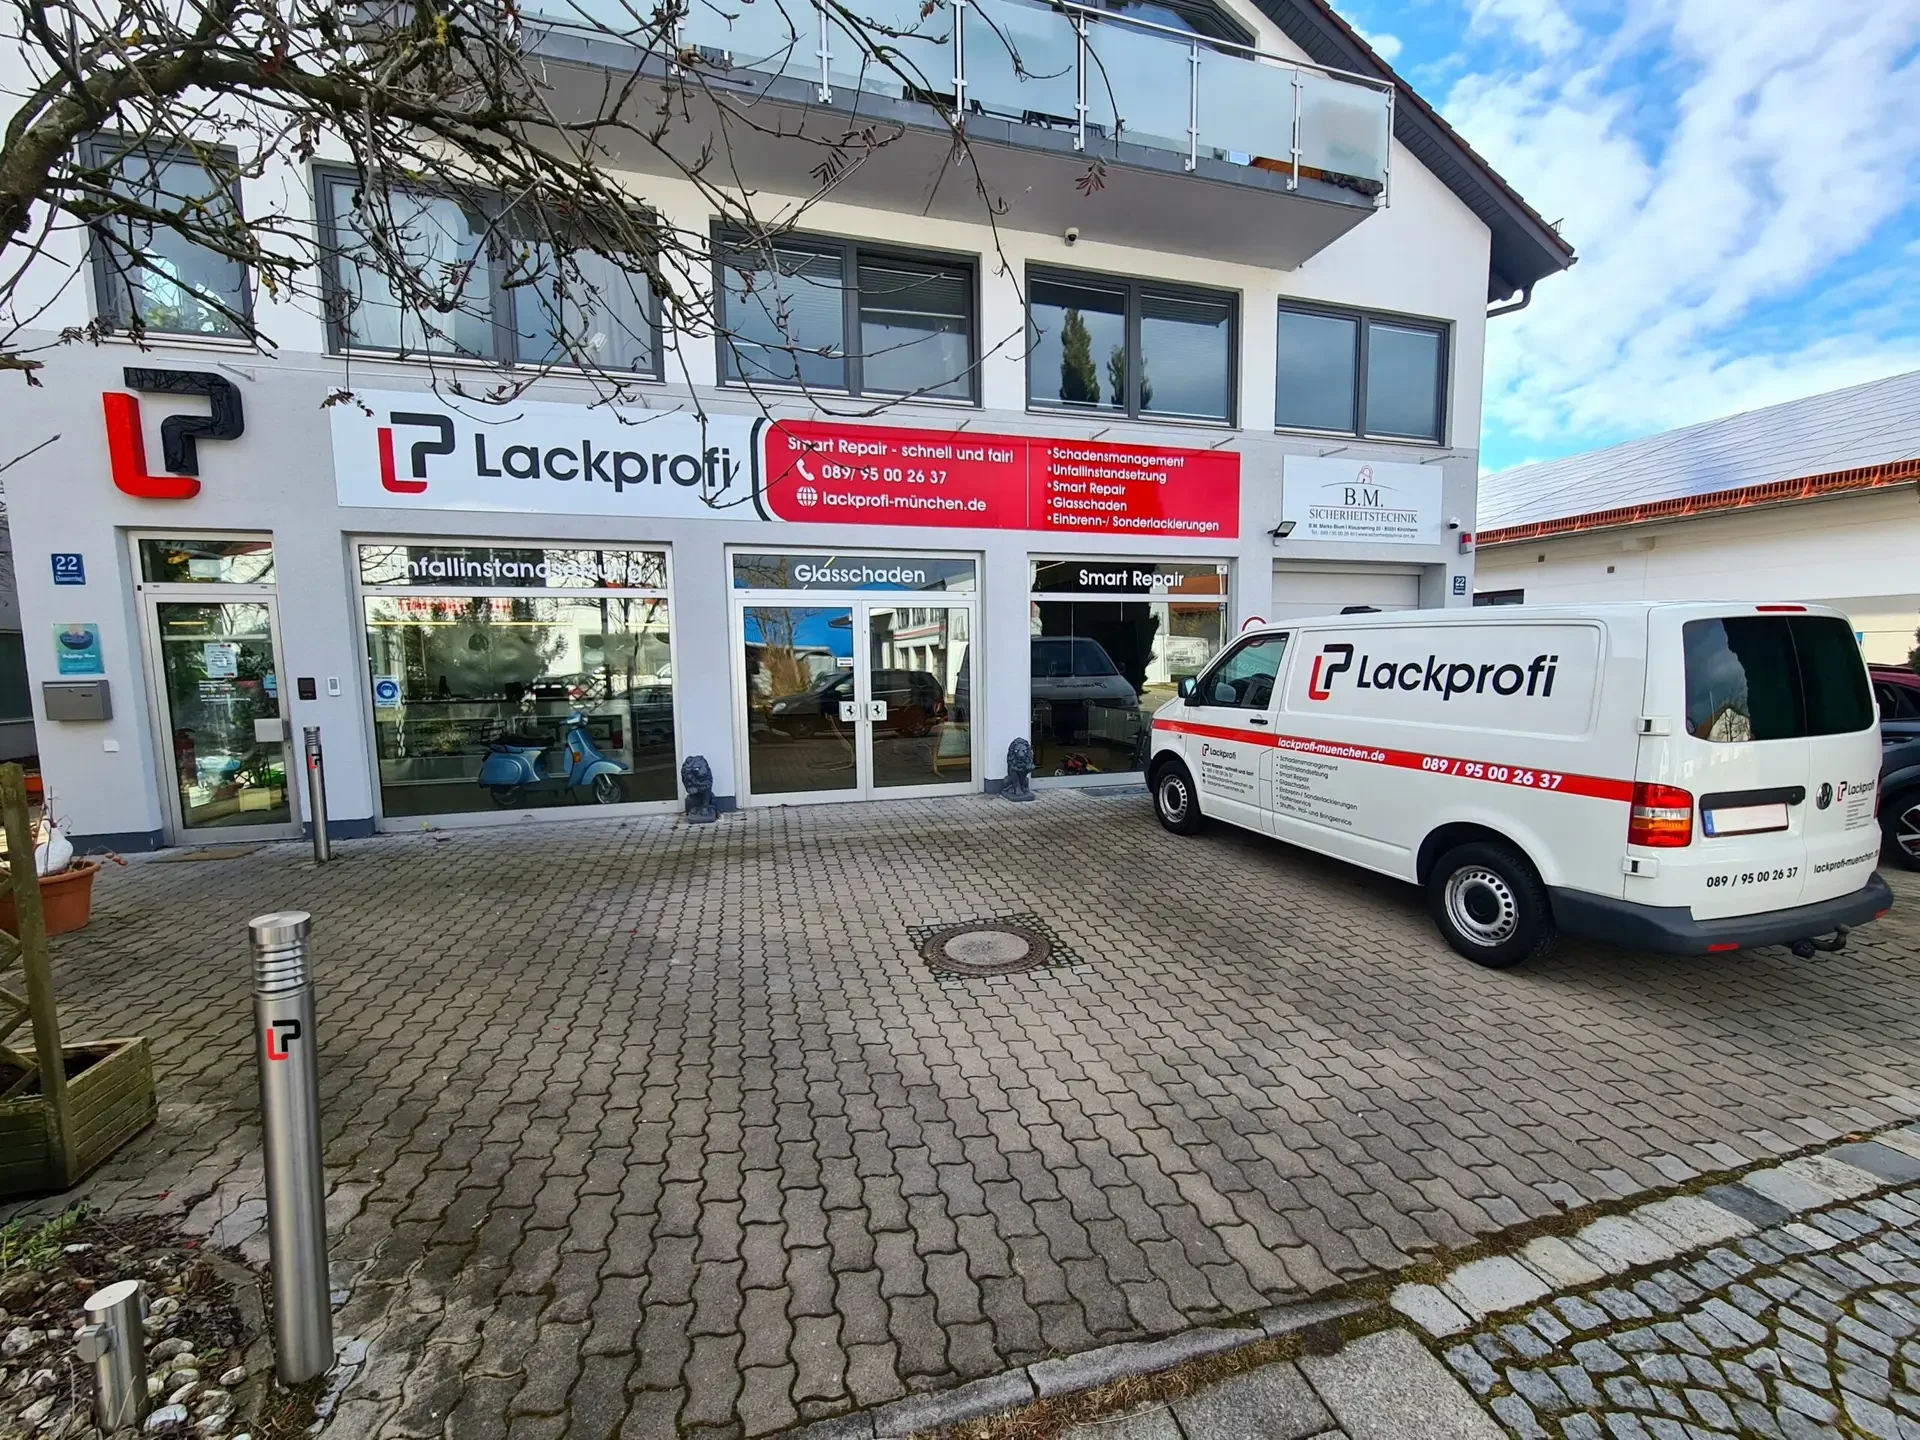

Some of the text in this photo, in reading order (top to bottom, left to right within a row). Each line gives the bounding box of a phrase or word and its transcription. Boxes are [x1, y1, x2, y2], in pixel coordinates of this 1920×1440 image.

[103, 367, 244, 499] LP
[377, 411, 731, 493] LP Lackprofi
[788, 437, 834, 453] Smart
[839, 439, 887, 457] Repair
[901, 444, 952, 459] schnell
[957, 446, 984, 461] und
[988, 449, 1014, 463] fair!
[1053, 448, 1184, 467] Schadensmanagement
[860, 466, 879, 481] 95
[883, 468, 902, 482] 00
[907, 469, 925, 483] 26
[930, 470, 947, 485] 37
[1053, 465, 1167, 484] Unfallinstandsetzung
[1053, 481, 1125, 496] Smart Repair
[1344, 487, 1384, 507] B.M.
[822, 491, 987, 512] lackprofi-münchen.de
[1053, 497, 1127, 511] Glasschaden
[1053, 513, 1219, 533] Einbrenn-/ Sonderlackierungen
[1309, 508, 1417, 523] SICHERHEITSTECHNIK
[56, 556, 78, 570] 22
[794, 564, 925, 583] Glasschaden
[1079, 569, 1184, 589] Smart Repair
[1455, 577, 1465, 586] 22
[1357, 655, 1559, 701] Lackprofi
[1210, 748, 1236, 759] Lackprofi
[1278, 737, 1385, 762] lackprofi-muenchen.de
[1280, 755, 1338, 771] Schadensmanagement
[1293, 774, 1309, 782] Repair
[1422, 757, 1448, 772] 089
[1465, 763, 1484, 777] 95
[1487, 766, 1508, 781] 00
[1512, 769, 1534, 785] 26
[1539, 773, 1562, 789] 37
[1279, 779, 1310, 790] Glasschaden
[1303, 792, 1358, 810] Sonderlackierungen
[1320, 812, 1352, 826] Bringservice
[1706, 875, 1728, 888] 089
[1741, 873, 1754, 884] 95
[1757, 871, 1770, 882] 00
[1772, 868, 1784, 880] 26
[1786, 866, 1798, 878] 37
